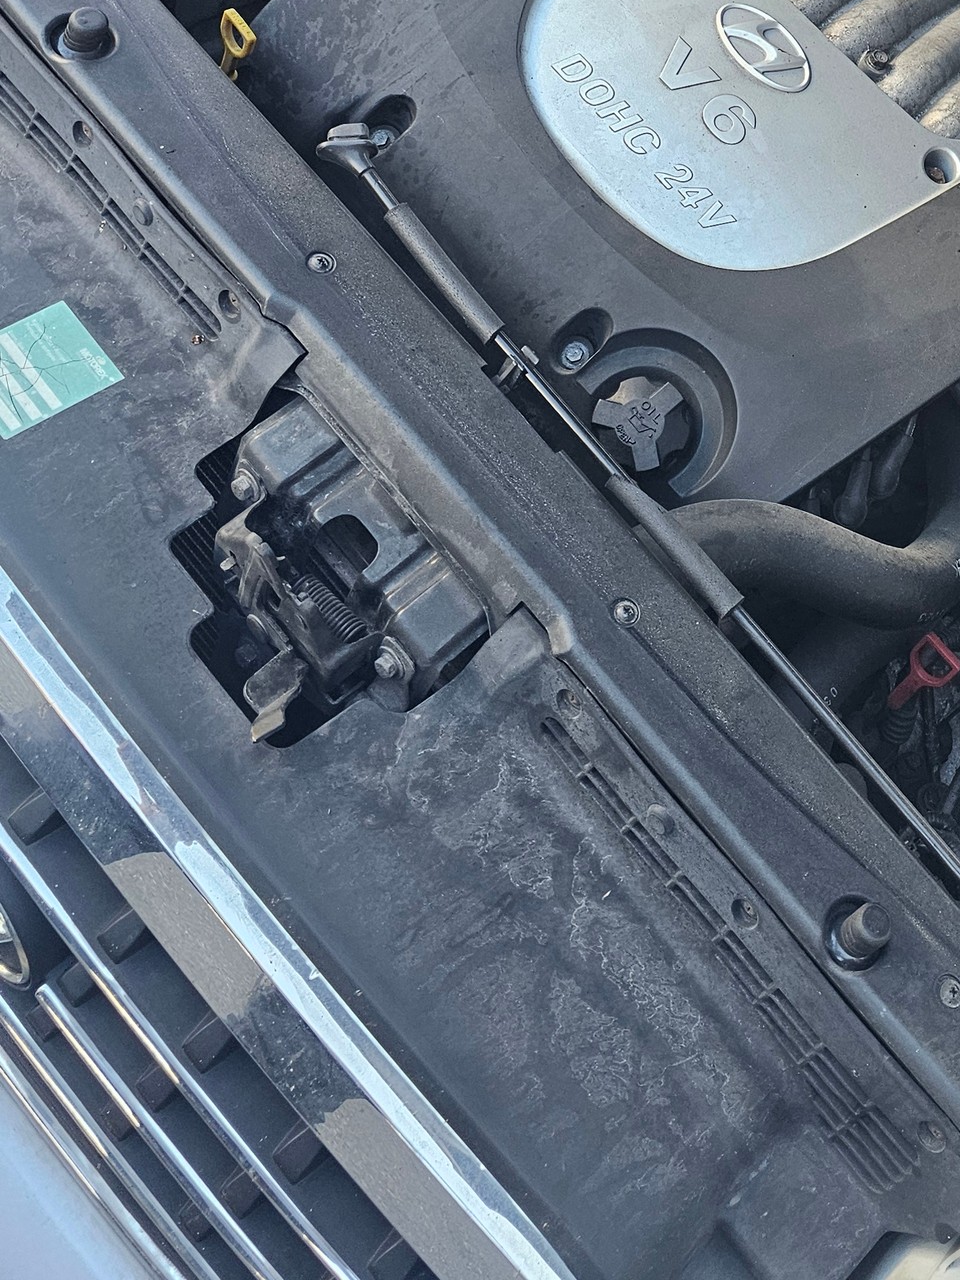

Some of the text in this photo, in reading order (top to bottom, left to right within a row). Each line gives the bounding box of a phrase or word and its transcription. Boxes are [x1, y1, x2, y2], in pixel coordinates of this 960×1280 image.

[658, 34, 756, 146] V6
[551, 53, 737, 229] DOHC 24V
[79, 348, 108, 380] MOTOREX
[641, 400, 661, 425] OIL
